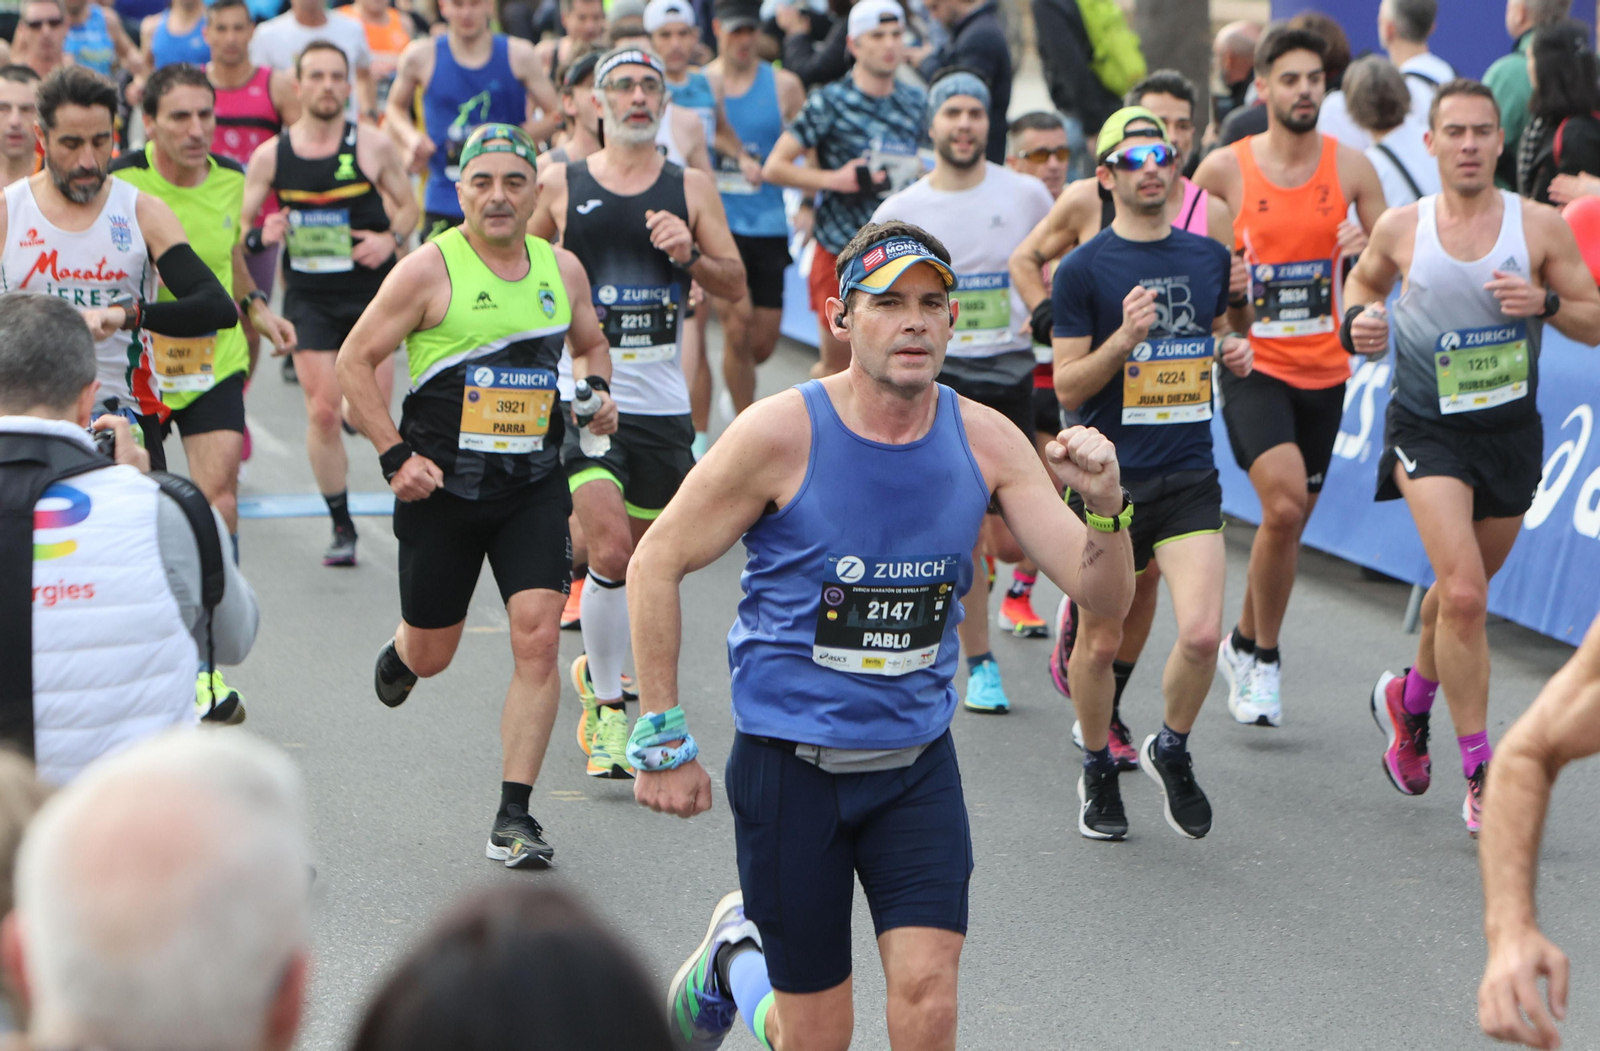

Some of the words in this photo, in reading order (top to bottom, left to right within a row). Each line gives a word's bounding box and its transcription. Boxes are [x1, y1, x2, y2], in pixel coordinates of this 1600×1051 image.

[622, 288, 670, 302] ZURICH
[621, 314, 652, 328] 2213
[620, 333, 653, 347] ÁNGEL
[1466, 328, 1516, 345] ZURICH
[1156, 342, 1205, 357] ZURICH
[499, 372, 548, 386] ZURICH
[1156, 371, 1186, 384] 4224
[1138, 394, 1164, 405] JUAN
[496, 400, 526, 414] 3921
[493, 423, 526, 434] PARRA
[873, 560, 946, 578] ZURICH
[866, 601, 914, 620] 2147
[862, 632, 910, 648] PABLO
